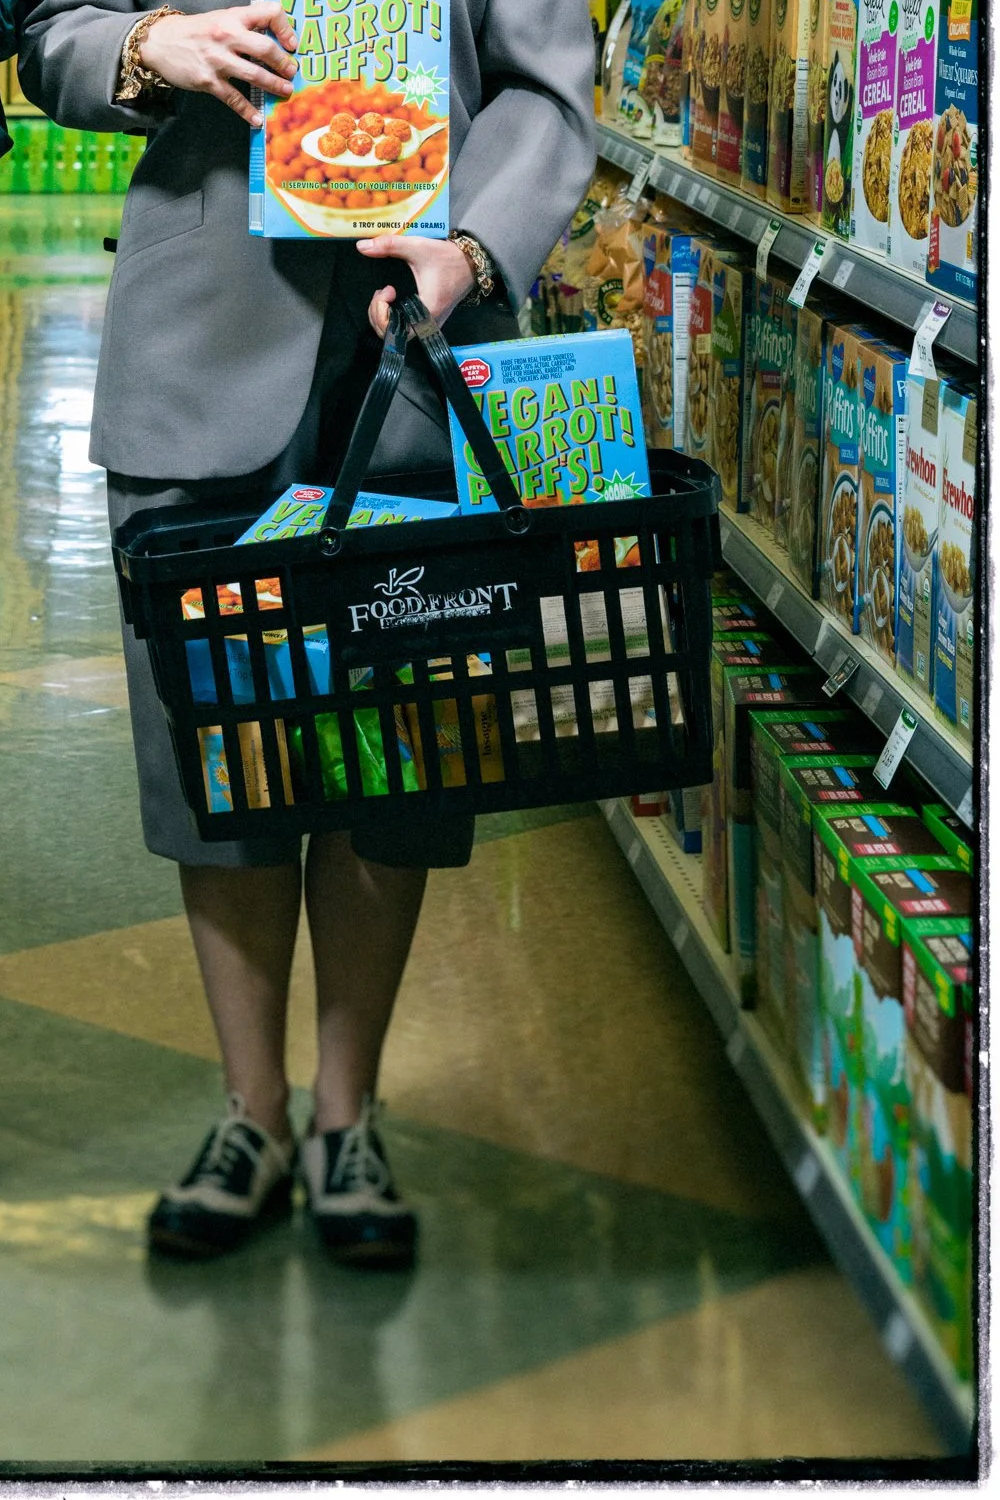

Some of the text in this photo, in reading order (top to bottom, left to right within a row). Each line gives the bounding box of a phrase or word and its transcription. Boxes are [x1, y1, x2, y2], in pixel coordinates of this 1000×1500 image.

[949, 22, 969, 36] ORGANIC
[292, 31, 408, 82] UFF'S!
[867, 67, 878, 81] Raisin
[938, 58, 978, 86] WHEAT SQUARES
[863, 80, 892, 108] CEREAL
[900, 89, 927, 118] CEREAL
[501, 364, 523, 372] CONTAINS
[534, 361, 550, 369] ACTUAL
[502, 370, 512, 378] SAFE
[513, 369, 522, 377] FOR
[523, 368, 544, 376] HUMANS,
[545, 366, 563, 374] RABBITS,
[514, 357, 527, 365] FROM
[527, 356, 538, 364] REAL
[539, 355, 552, 363] FIBER
[552, 353, 575, 361] SOURCES!
[502, 377, 517, 385] COWS,
[518, 375, 539, 383] CHICKENS
[827, 378, 855, 439] Puffins
[859, 400, 889, 467] Puffins
[467, 441, 604, 505] PFF'S!
[905, 436, 937, 488] Erewhon
[942, 467, 975, 522] Erewho
[348, 596, 422, 633] FOOD
[428, 582, 518, 613] FRONT
